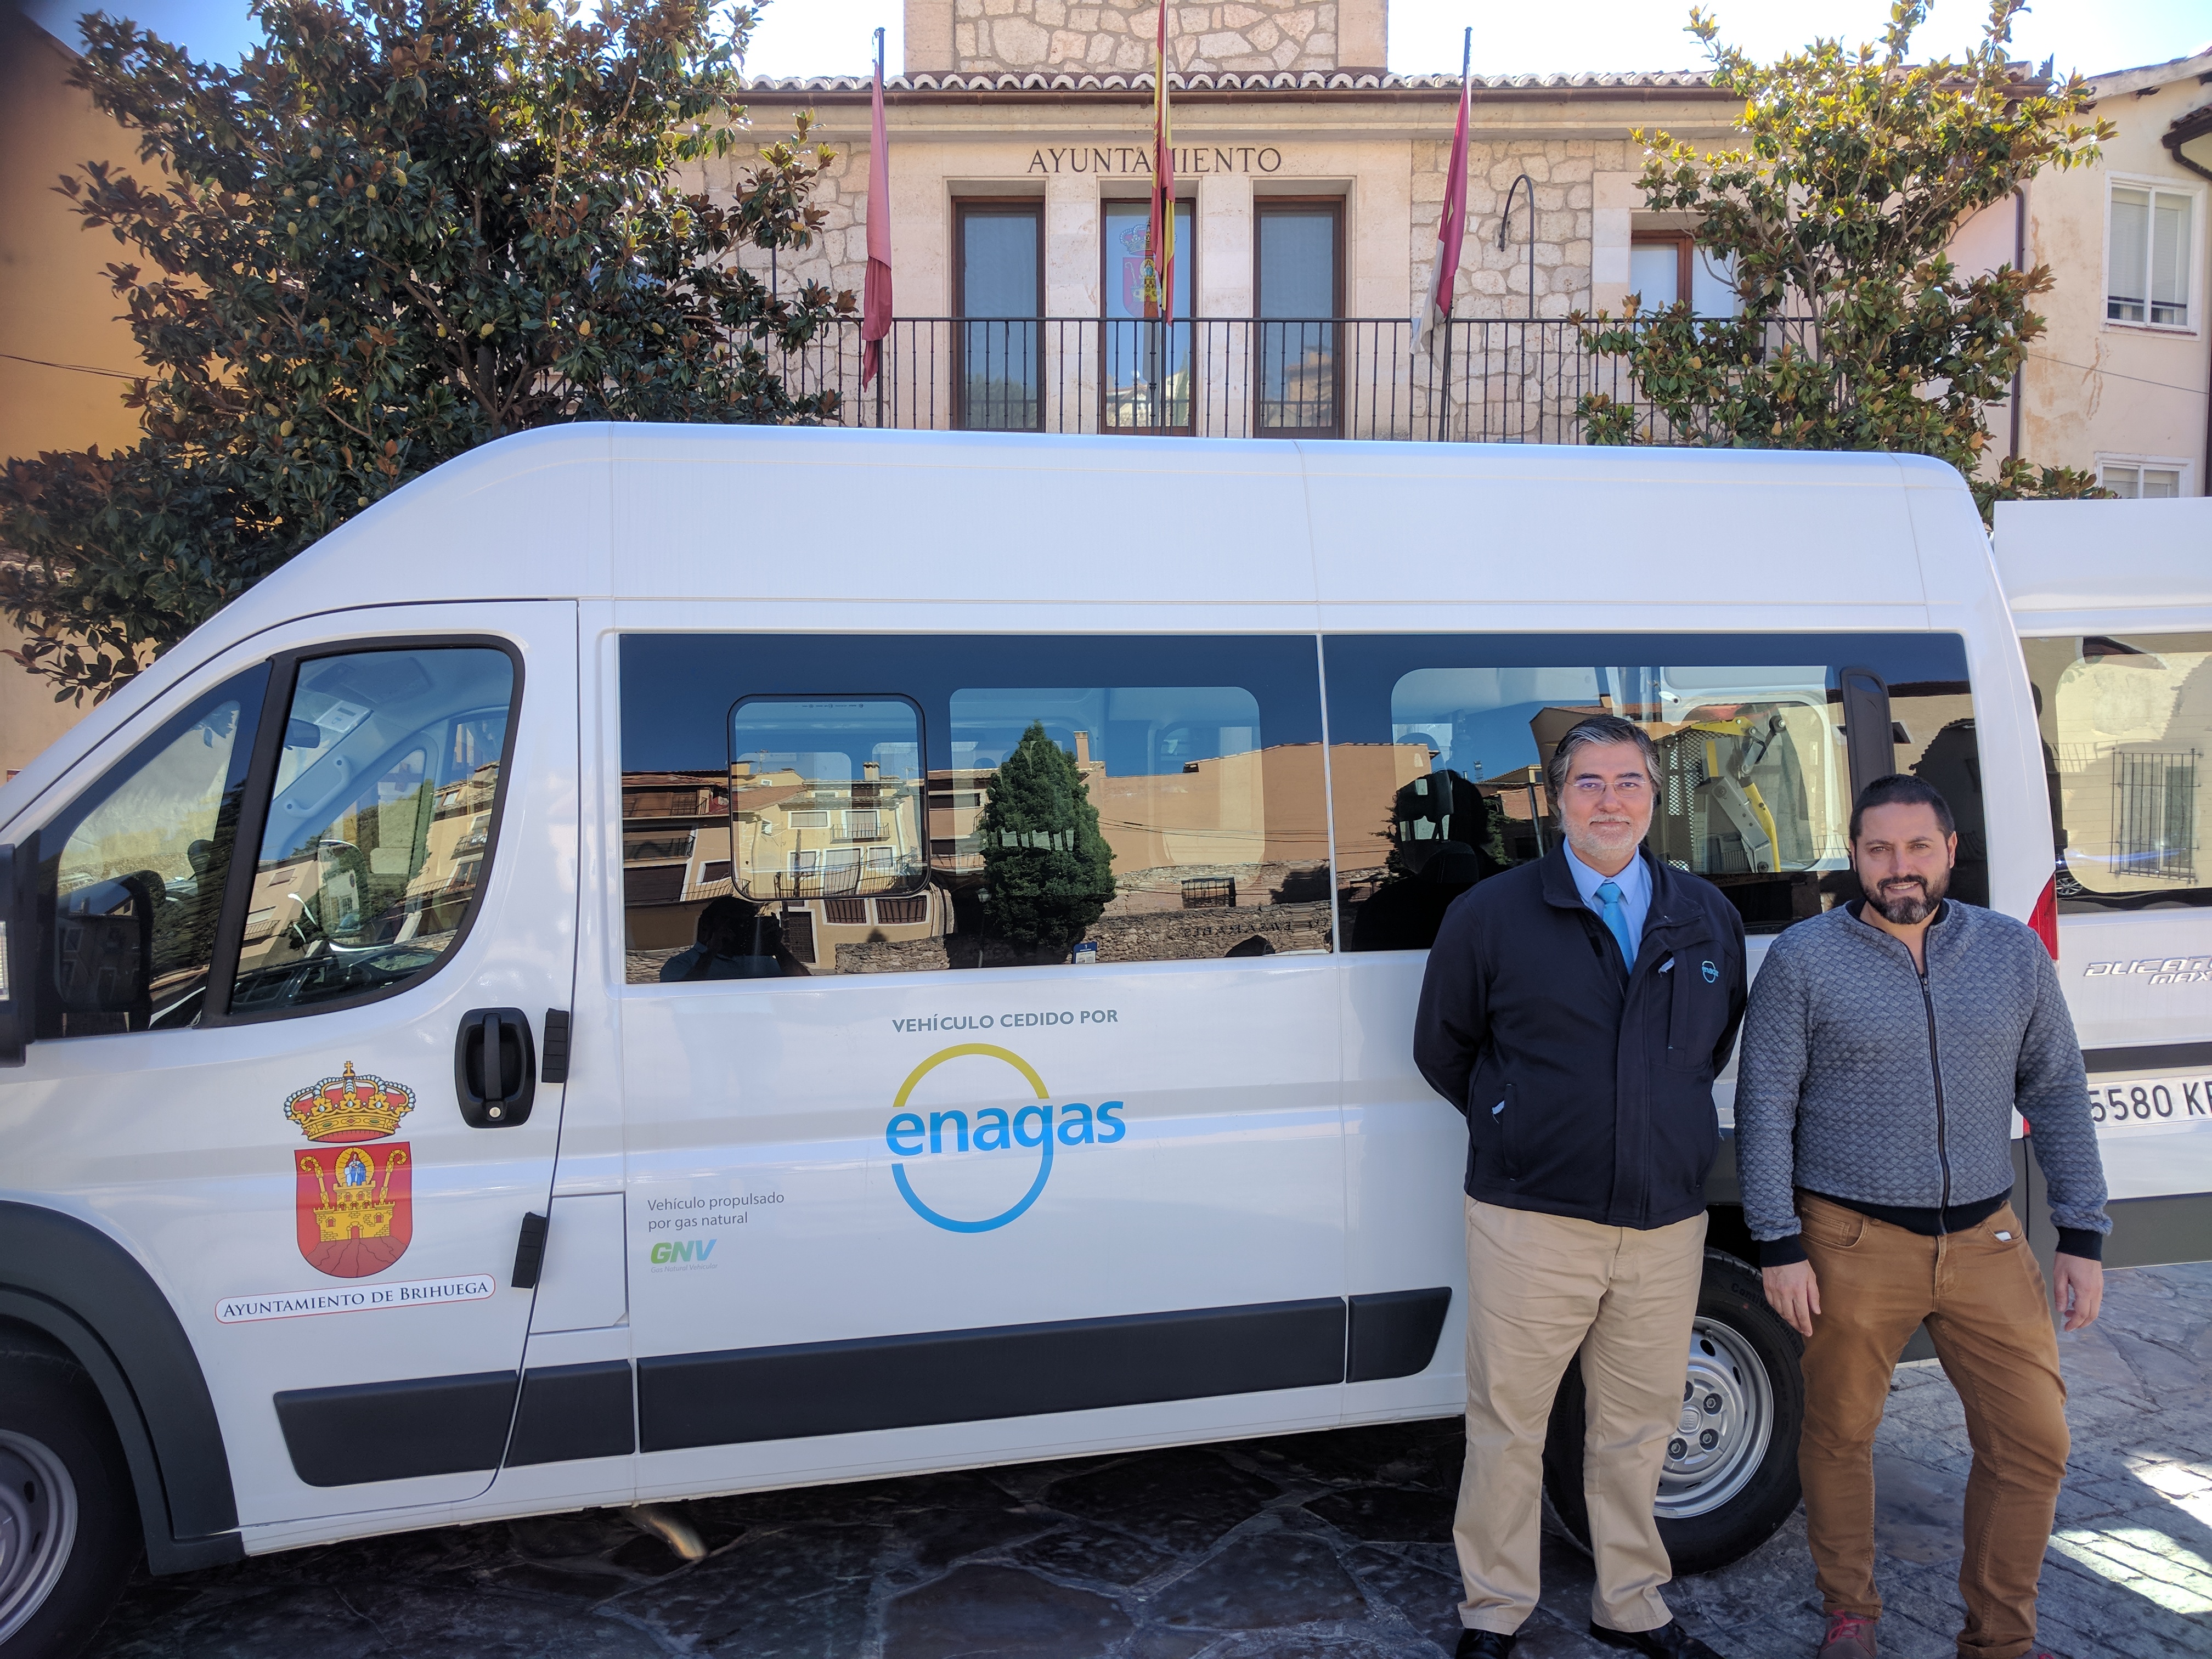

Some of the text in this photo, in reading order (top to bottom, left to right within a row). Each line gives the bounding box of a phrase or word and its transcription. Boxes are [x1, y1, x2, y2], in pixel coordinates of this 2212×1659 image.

[1027, 148, 1281, 173] AYUNTAIENTO
[2083, 955, 2212, 977] DUCAT
[2148, 969, 2212, 985] MAX
[891, 1009, 1118, 1033] VEHÍCULO CEDIDO POR
[885, 1100, 1126, 1157] enagas
[647, 1191, 785, 1211] Vehículo propulsado
[648, 1211, 748, 1232] por gas natural
[650, 1239, 718, 1264] GNV
[664, 1264, 688, 1272] Natural
[223, 1280, 489, 1318] AYUNTAMIENTO DE BRIHUEGA
